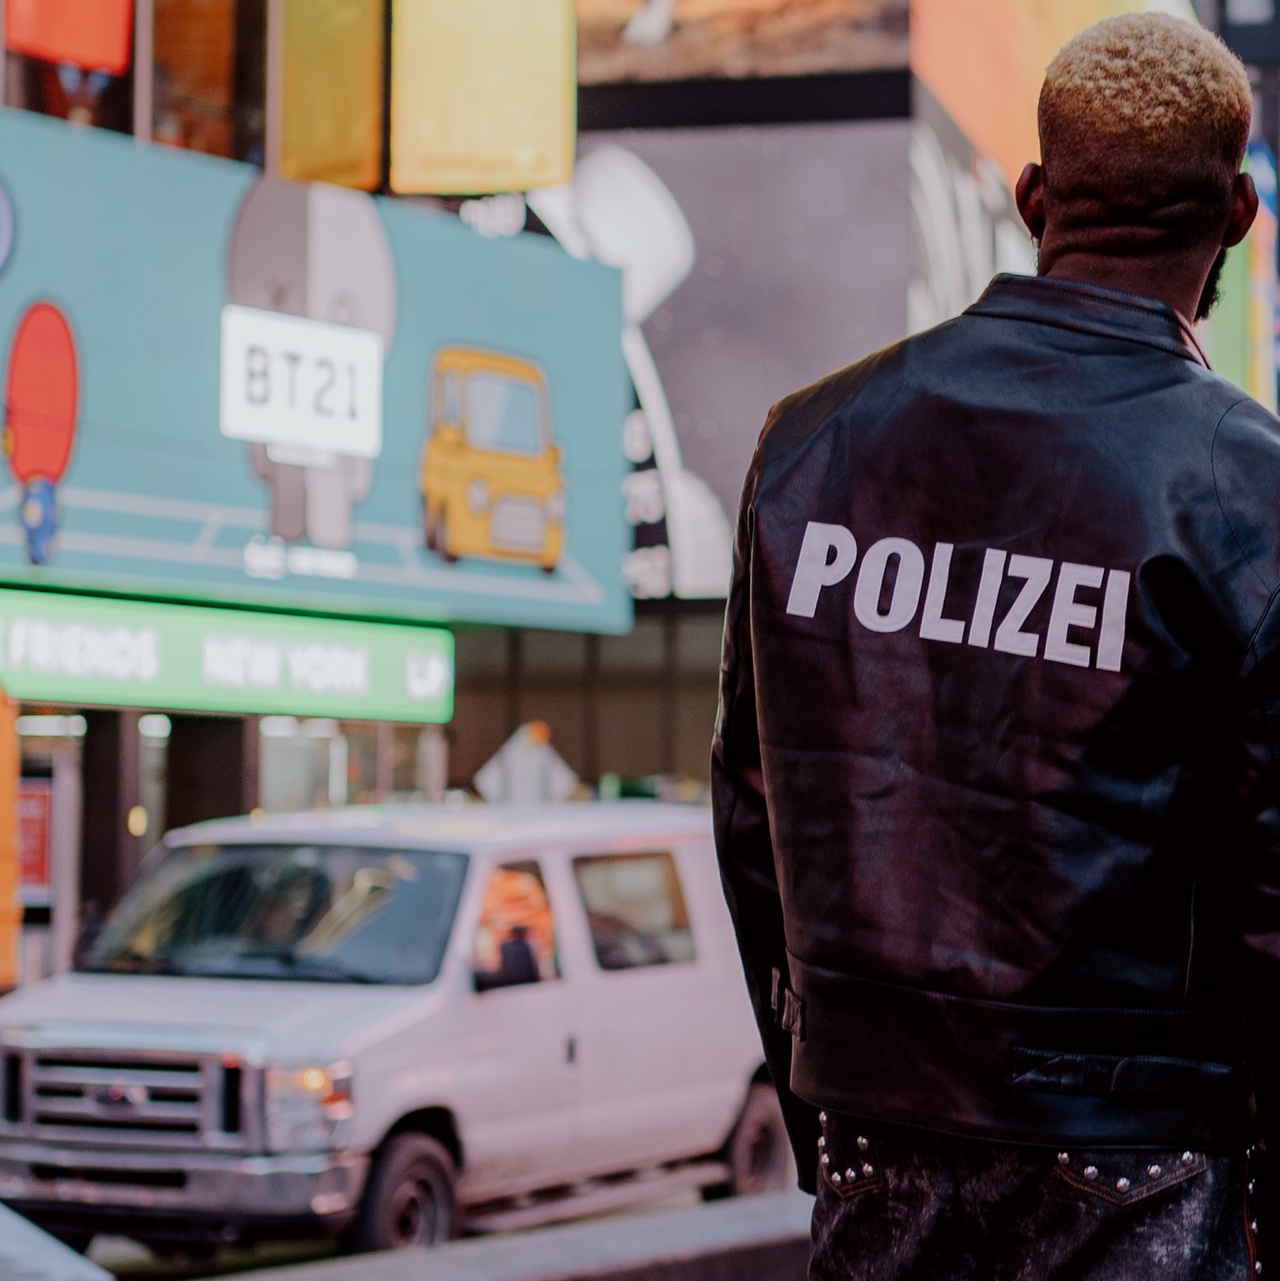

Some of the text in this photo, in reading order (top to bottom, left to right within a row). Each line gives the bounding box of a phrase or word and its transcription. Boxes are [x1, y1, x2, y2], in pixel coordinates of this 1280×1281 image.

[245, 342, 360, 421] BT21
[786, 521, 1131, 672] POLIZEI
[8, 619, 160, 682] FRIENDS
[202, 636, 282, 686] NEW
[287, 643, 372, 694] YORK
